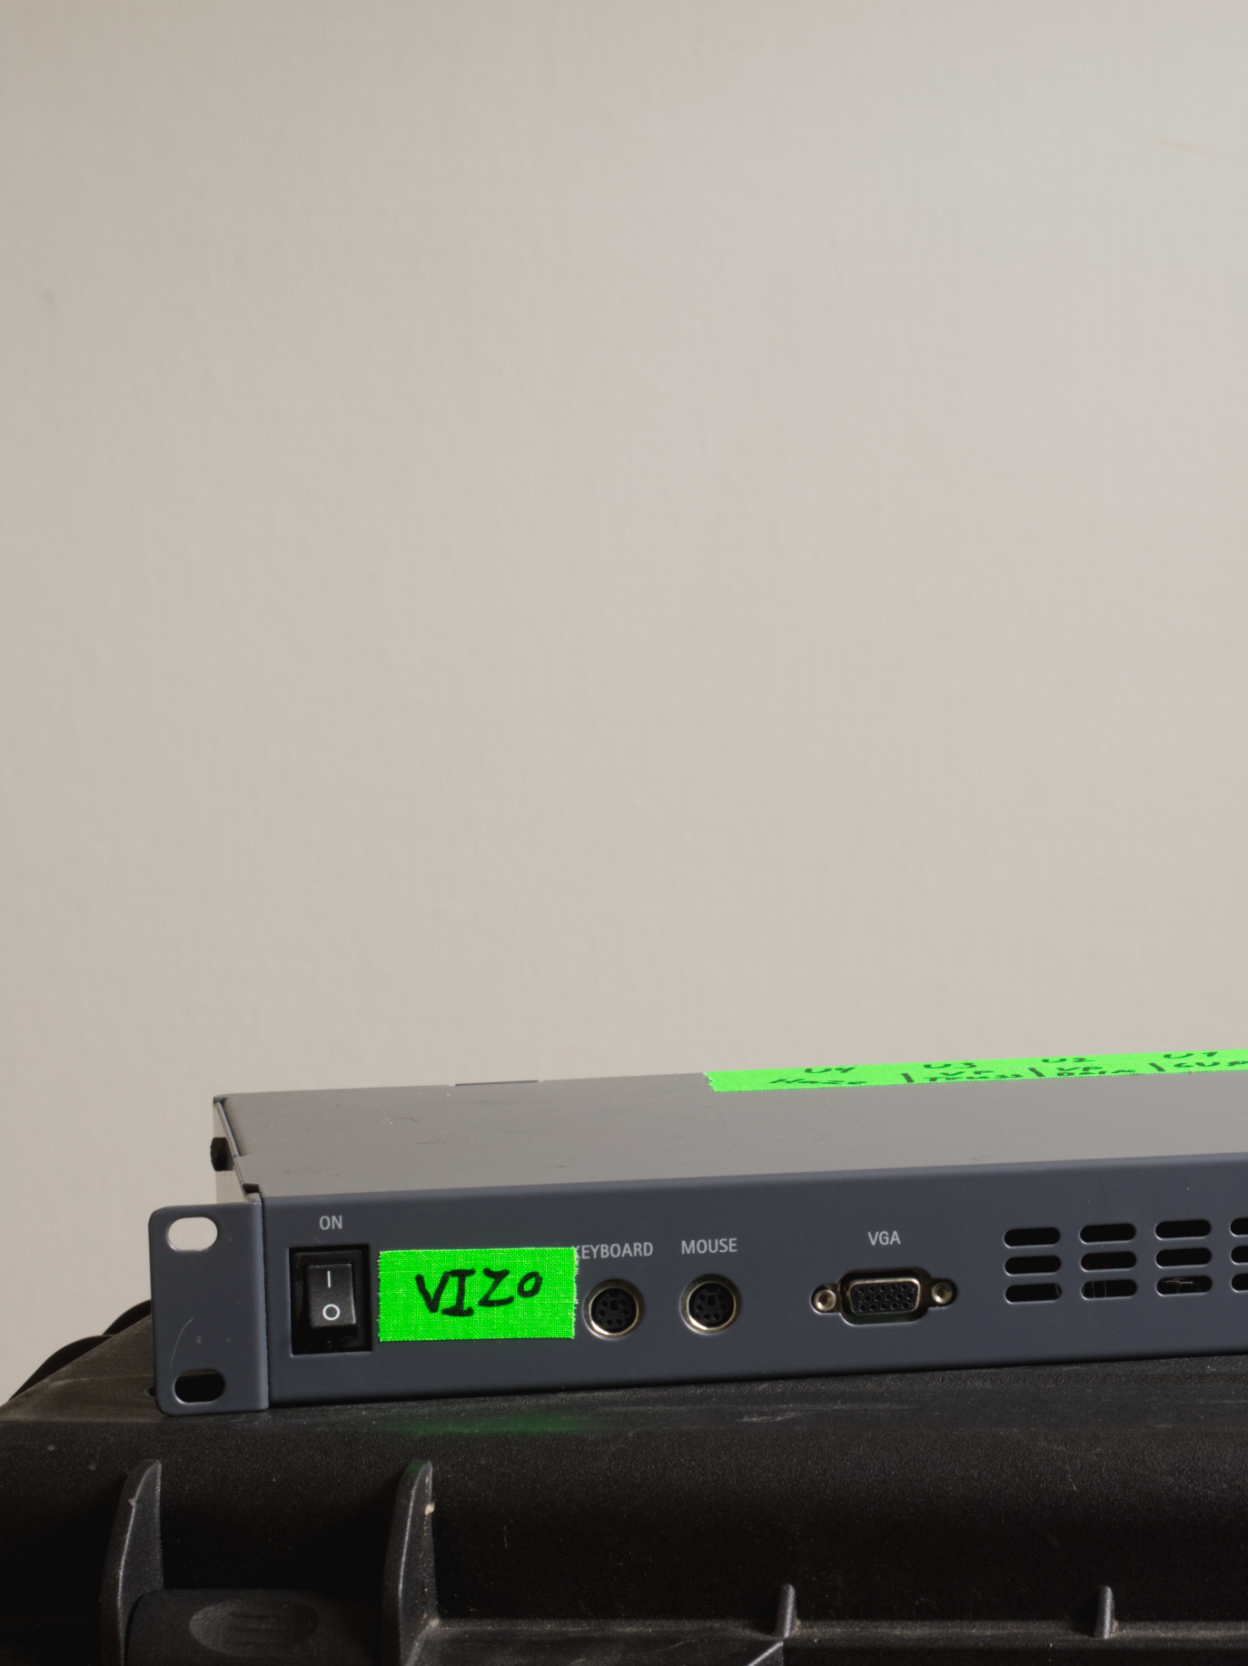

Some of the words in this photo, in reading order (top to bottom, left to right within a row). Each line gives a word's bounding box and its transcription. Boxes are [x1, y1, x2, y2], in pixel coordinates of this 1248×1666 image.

[319, 1214, 344, 1231] ON
[680, 1237, 739, 1255] MOUSE
[867, 1229, 902, 1247] VGA
